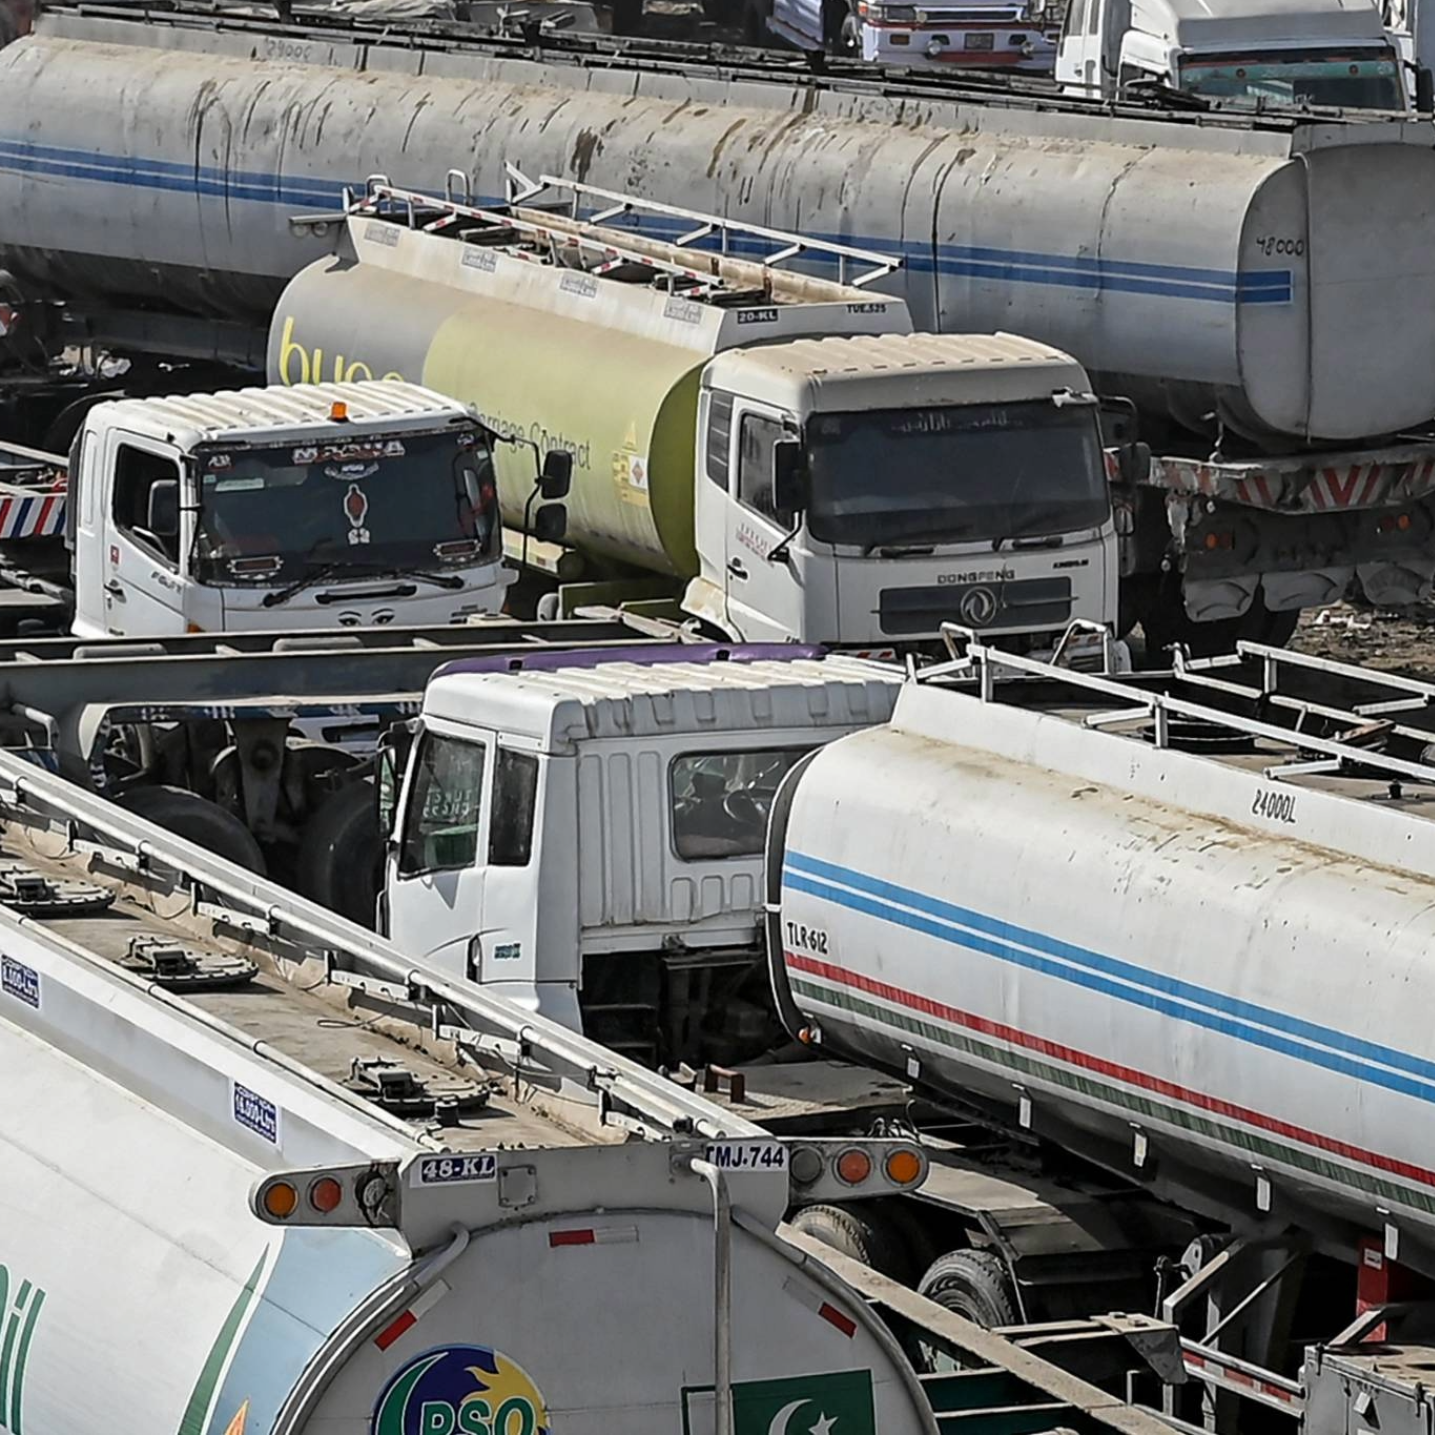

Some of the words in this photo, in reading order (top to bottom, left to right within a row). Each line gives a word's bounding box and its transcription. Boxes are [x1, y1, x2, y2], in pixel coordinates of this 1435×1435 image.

[1256, 236, 1305, 256] 48000
[739, 311, 777, 323] 20-KL
[938, 569, 1015, 584] DONGFENG
[423, 1157, 495, 1179] 48-KL
[420, 1396, 537, 1435] PSO
